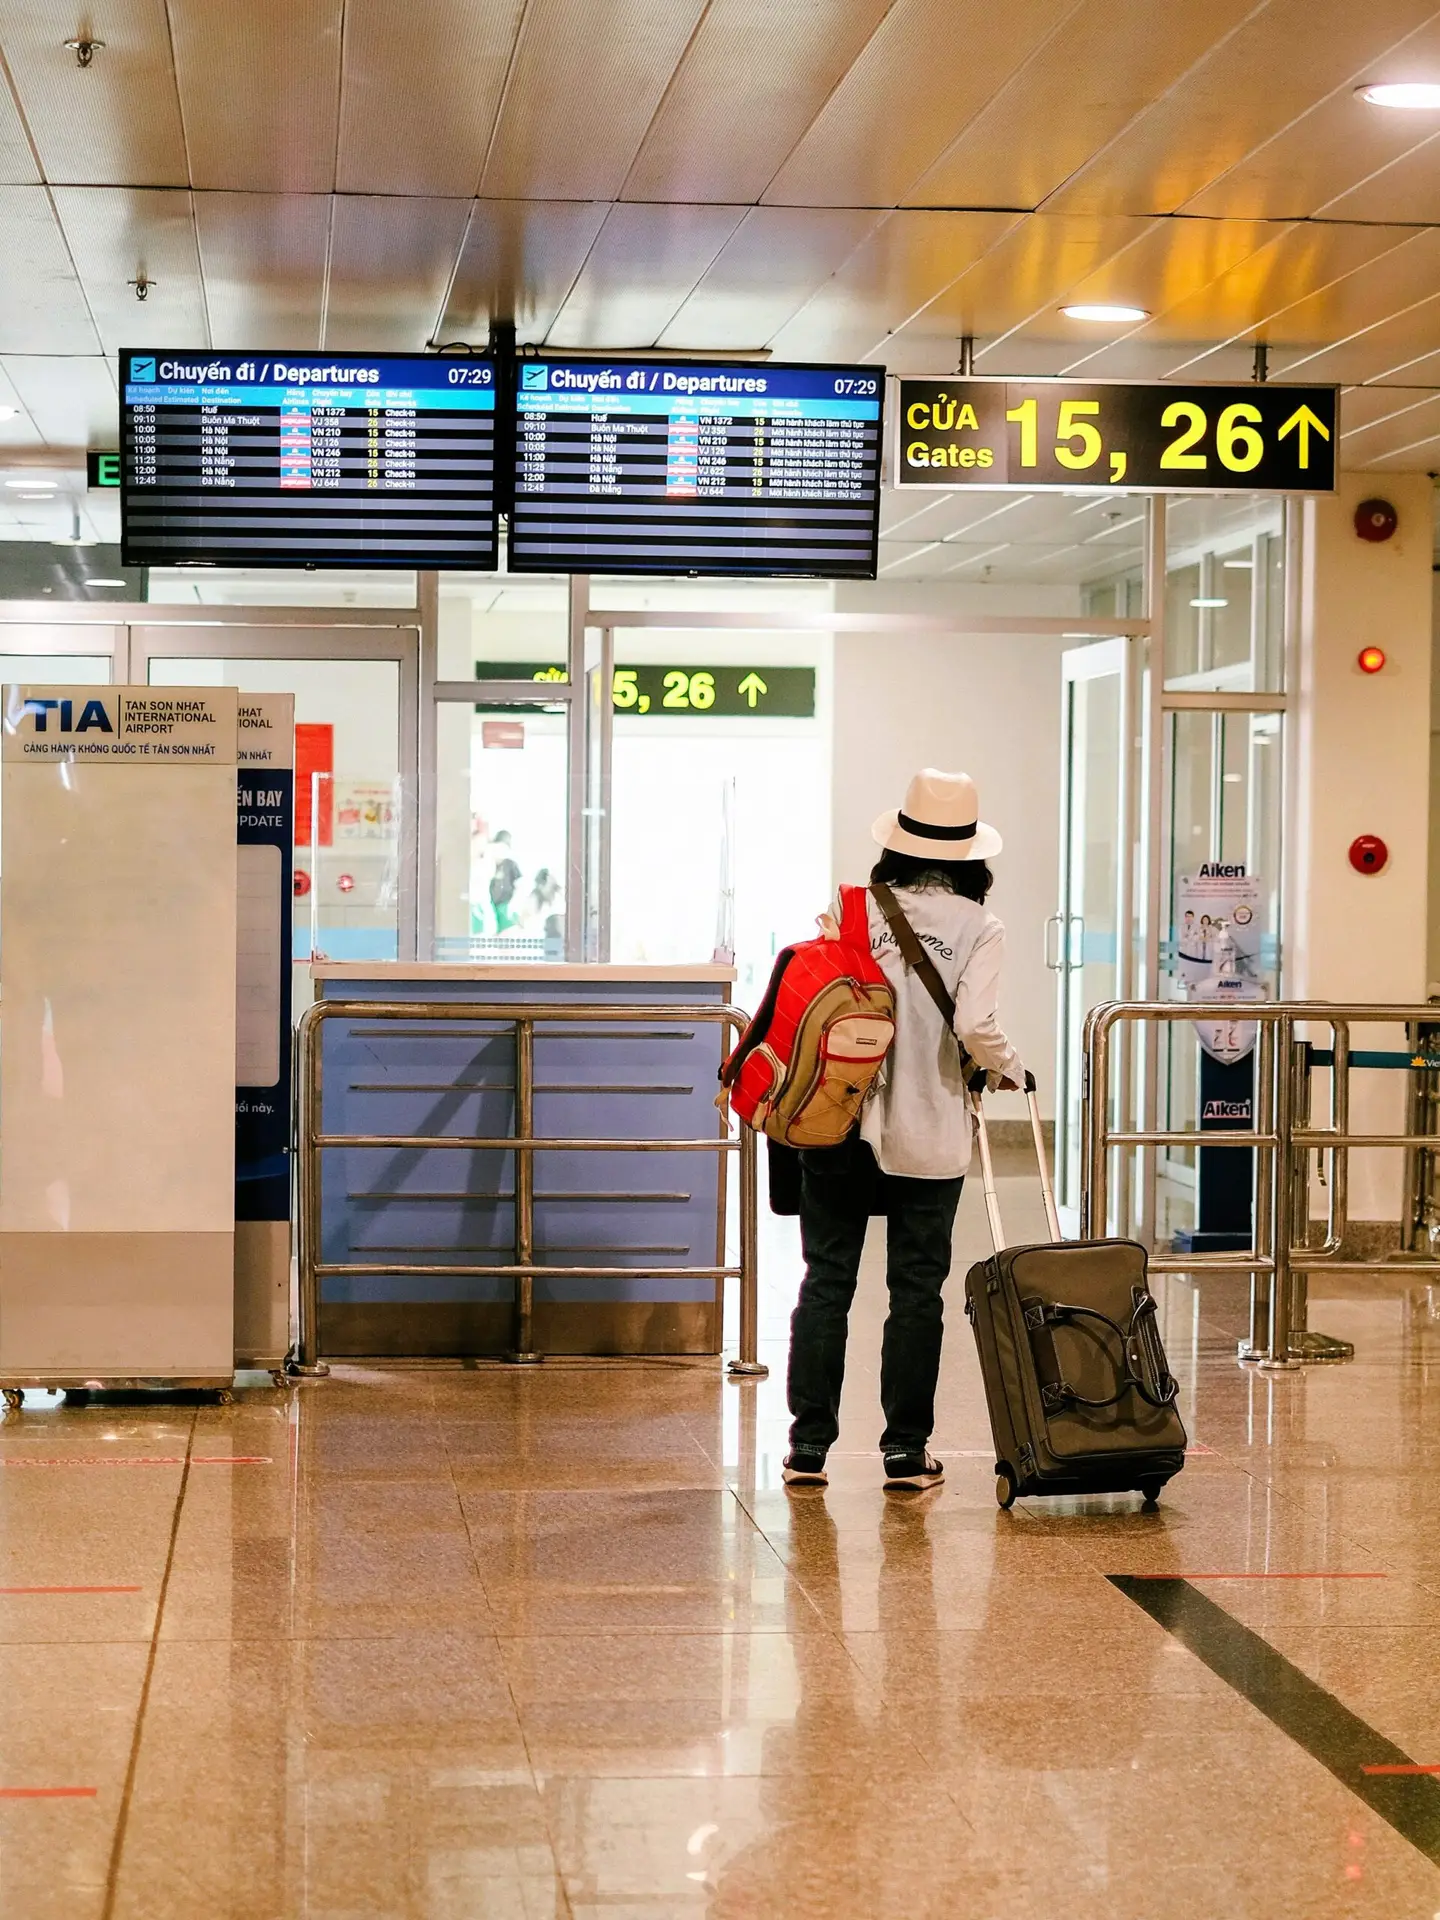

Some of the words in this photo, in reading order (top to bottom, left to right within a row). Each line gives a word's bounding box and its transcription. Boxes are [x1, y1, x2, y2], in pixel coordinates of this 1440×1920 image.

[160, 360, 231, 385] Chuyến
[236, 363, 256, 381] đi
[260, 364, 268, 381] /
[274, 364, 380, 386] Departures
[448, 368, 492, 384] 07:29
[551, 369, 622, 392] Chuyến
[626, 372, 646, 390] đi
[650, 373, 657, 391] /
[663, 372, 767, 395] Departures
[834, 379, 876, 395] 07:29
[202, 406, 218, 414] Huế
[312, 418, 322, 426] VJ
[312, 428, 325, 436] VN
[312, 438, 322, 446] VJ
[907, 393, 979, 430] CỬA
[1006, 398, 1128, 483] 15,
[1160, 402, 1264, 472] 26
[134, 446, 156, 454] 11:00
[907, 442, 994, 469] Gates
[134, 456, 156, 464] 11:25
[524, 453, 545, 461] 11:00
[99, 455, 120, 485] E
[134, 466, 156, 474] 12:00
[312, 469, 325, 477] VN
[523, 473, 544, 481] 12:00
[312, 479, 322, 487] VJ
[662, 670, 716, 709] 26
[126, 701, 146, 710] TAN
[150, 701, 173, 710] SON
[176, 702, 206, 711] NHAT
[24, 699, 114, 732] TIA
[124, 712, 216, 722] INTERNATIONAL
[126, 724, 174, 733] AIRPORT
[24, 740, 48, 753] CẢNG
[50, 740, 76, 753] HÀNG
[78, 742, 109, 754] KHÔNG
[112, 741, 136, 754] QUỐC
[139, 742, 149, 754] TẾ
[152, 742, 170, 754] TÂN
[172, 744, 190, 754] SƠN
[192, 742, 216, 755] NHẤT
[256, 790, 282, 806] BAY
[238, 815, 283, 826] PDATE
[1200, 864, 1245, 877] Aiken
[1218, 980, 1242, 988] Aiken
[252, 1102, 274, 1114] này.
[1204, 1100, 1250, 1117] Aiken
